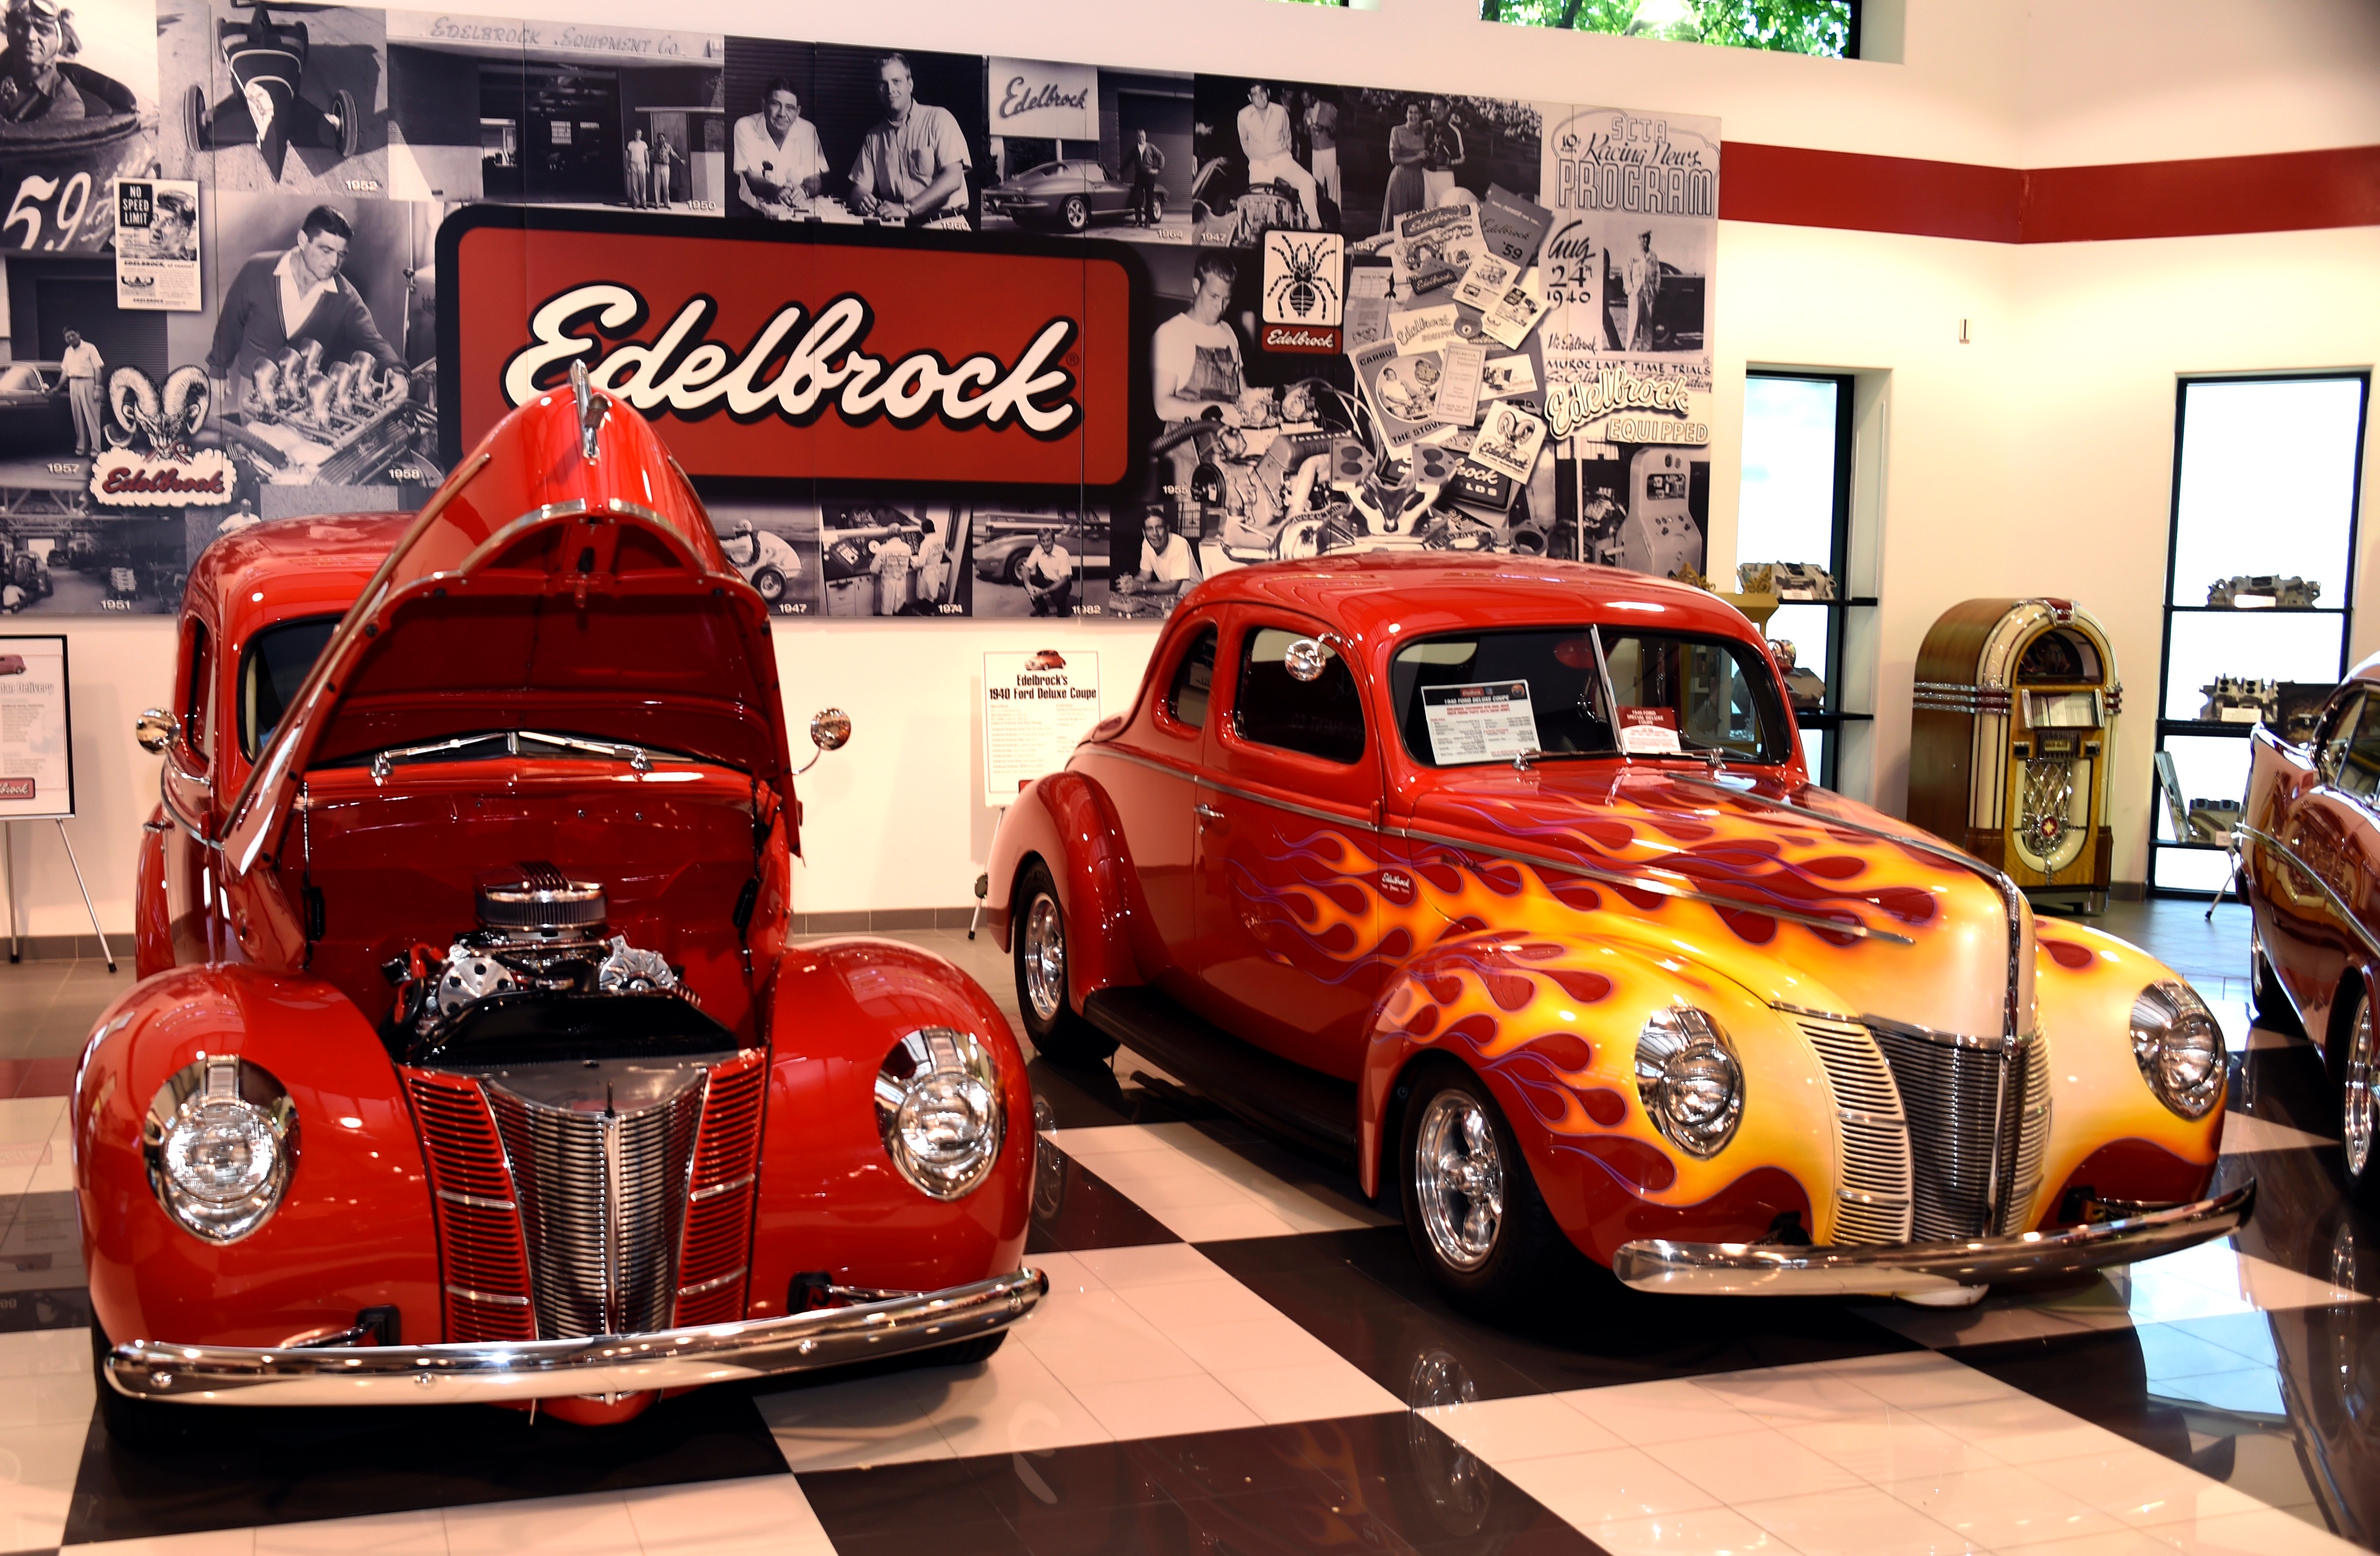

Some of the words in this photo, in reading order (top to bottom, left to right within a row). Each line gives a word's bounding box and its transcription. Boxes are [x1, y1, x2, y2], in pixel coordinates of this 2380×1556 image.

[431, 16, 541, 44] EDELBROCK
[557, 27, 652, 52] EQUIPMENT
[999, 76, 1088, 118] Edelbrock
[1612, 116, 1667, 144] SCTA
[1580, 132, 1647, 167] Racing
[1649, 142, 1702, 167] News
[130, 185, 142, 199] NO
[346, 180, 379, 192] 1952
[1555, 159, 1714, 218] PROGRAM
[122, 198, 150, 212] SPEED
[687, 200, 716, 210] 1950
[125, 211, 148, 225] LIMIT
[941, 221, 970, 232] 1960
[1157, 229, 1183, 239] 1964
[1201, 233, 1226, 243] 1947
[1548, 218, 1597, 266] Aug
[1351, 241, 1377, 251] 1947
[1502, 241, 1523, 260] '59
[1547, 290, 1591, 310] 1940
[1397, 313, 1451, 346] Edelbrock
[1267, 329, 1334, 348] Edelbrock
[505, 285, 1073, 432] Edelbrock
[1545, 358, 1591, 371] MUROC
[1633, 362, 1665, 374] TIME
[1672, 363, 1711, 376] TRIALS
[1546, 366, 1689, 439] Edelbrock
[1392, 429, 1412, 444] THE
[1607, 417, 1708, 443] EQUIPPED
[47, 462, 79, 474] 1957
[388, 468, 420, 479] 1958
[101, 466, 225, 494] Edelbrock
[1163, 485, 1189, 495] 1955
[100, 599, 130, 610] 1951
[779, 603, 807, 613] 1947
[937, 604, 963, 614] 1974
[1017, 674, 1068, 686] Edelbrock's
[989, 687, 1010, 700] 1940
[1013, 687, 1035, 700] Ford
[1037, 687, 1067, 700] Deluxe
[1070, 686, 1097, 701] Coupe
